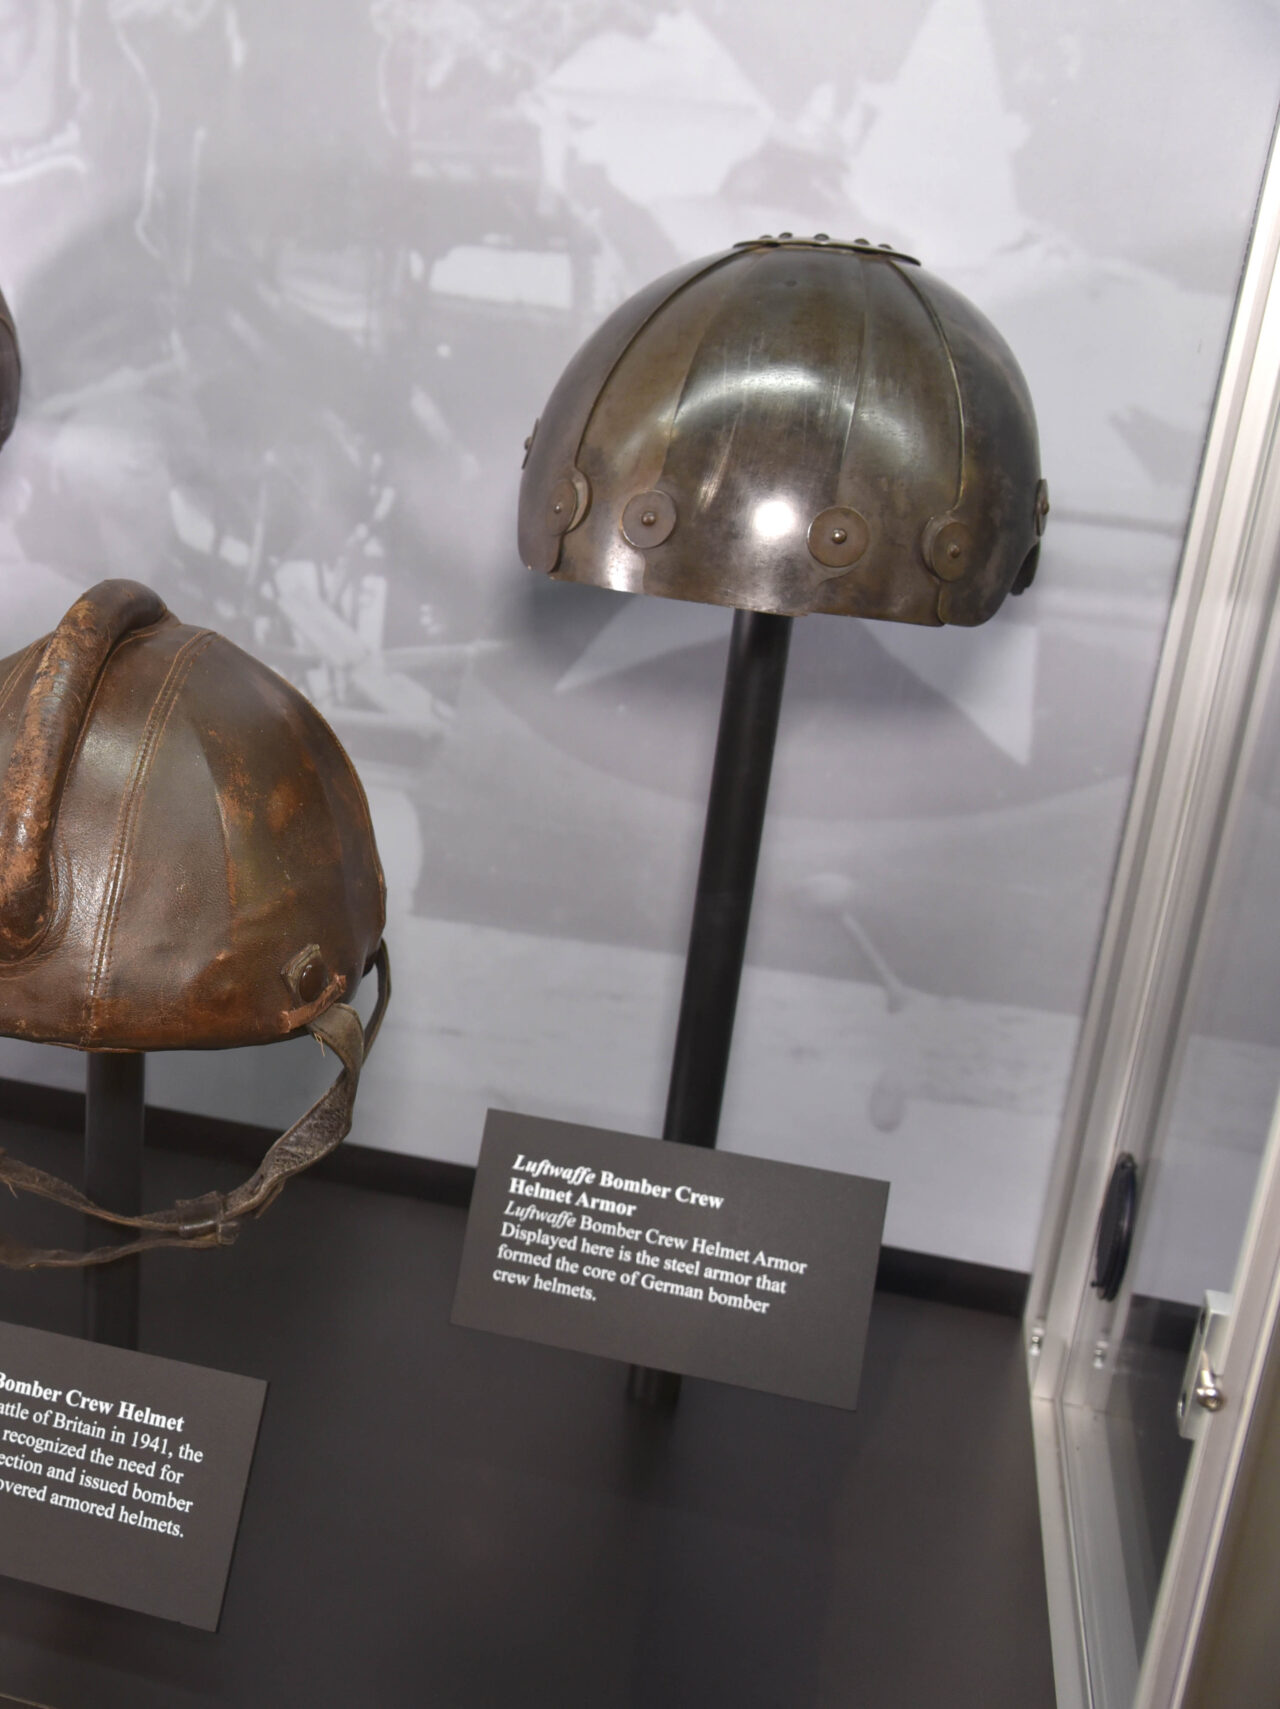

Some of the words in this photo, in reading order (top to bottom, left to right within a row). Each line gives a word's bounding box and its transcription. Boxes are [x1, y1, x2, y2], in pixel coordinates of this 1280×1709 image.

[509, 1177, 572, 1204] Helmet
[575, 1192, 637, 1216] Armor
[512, 1154, 596, 1185] Luftwaffe
[599, 1170, 671, 1198] Bomber
[674, 1185, 724, 1208] Crew
[500, 1221, 577, 1250] Displayed
[580, 1237, 614, 1258] here
[618, 1245, 631, 1262] is
[635, 1249, 660, 1267] the
[663, 1259, 700, 1276] steel
[703, 1267, 752, 1286] armor
[756, 1274, 786, 1294] that
[504, 1200, 576, 1228] Luftwaffe
[579, 1215, 642, 1241] Bomber
[645, 1228, 688, 1249] Crew
[691, 1237, 750, 1263] Helmet
[752, 1250, 807, 1274] Armor
[492, 1269, 530, 1286] crew
[533, 1273, 596, 1301] helmets.
[497, 1243, 551, 1268] formed
[555, 1256, 579, 1274] the
[582, 1265, 616, 1282] core
[619, 1270, 640, 1286] of
[640, 1274, 703, 1300] German
[708, 1286, 770, 1313] bomber
[32, 1409, 53, 1425] of
[52, 1412, 105, 1439] Britain
[110, 1425, 125, 1444] in
[131, 1431, 172, 1458] 1941,
[178, 1443, 203, 1463] the
[65, 1389, 114, 1414] Crew
[117, 1401, 184, 1432] Helmet
[2, 1429, 87, 1460] recognized
[89, 1447, 114, 1467] the
[117, 1458, 156, 1477] need
[159, 1464, 184, 1484] for
[46, 1466, 76, 1483] and
[78, 1469, 128, 1496] issued
[132, 1482, 193, 1512] bomber
[49, 1492, 115, 1519] armored
[118, 1505, 183, 1537] helmets.
